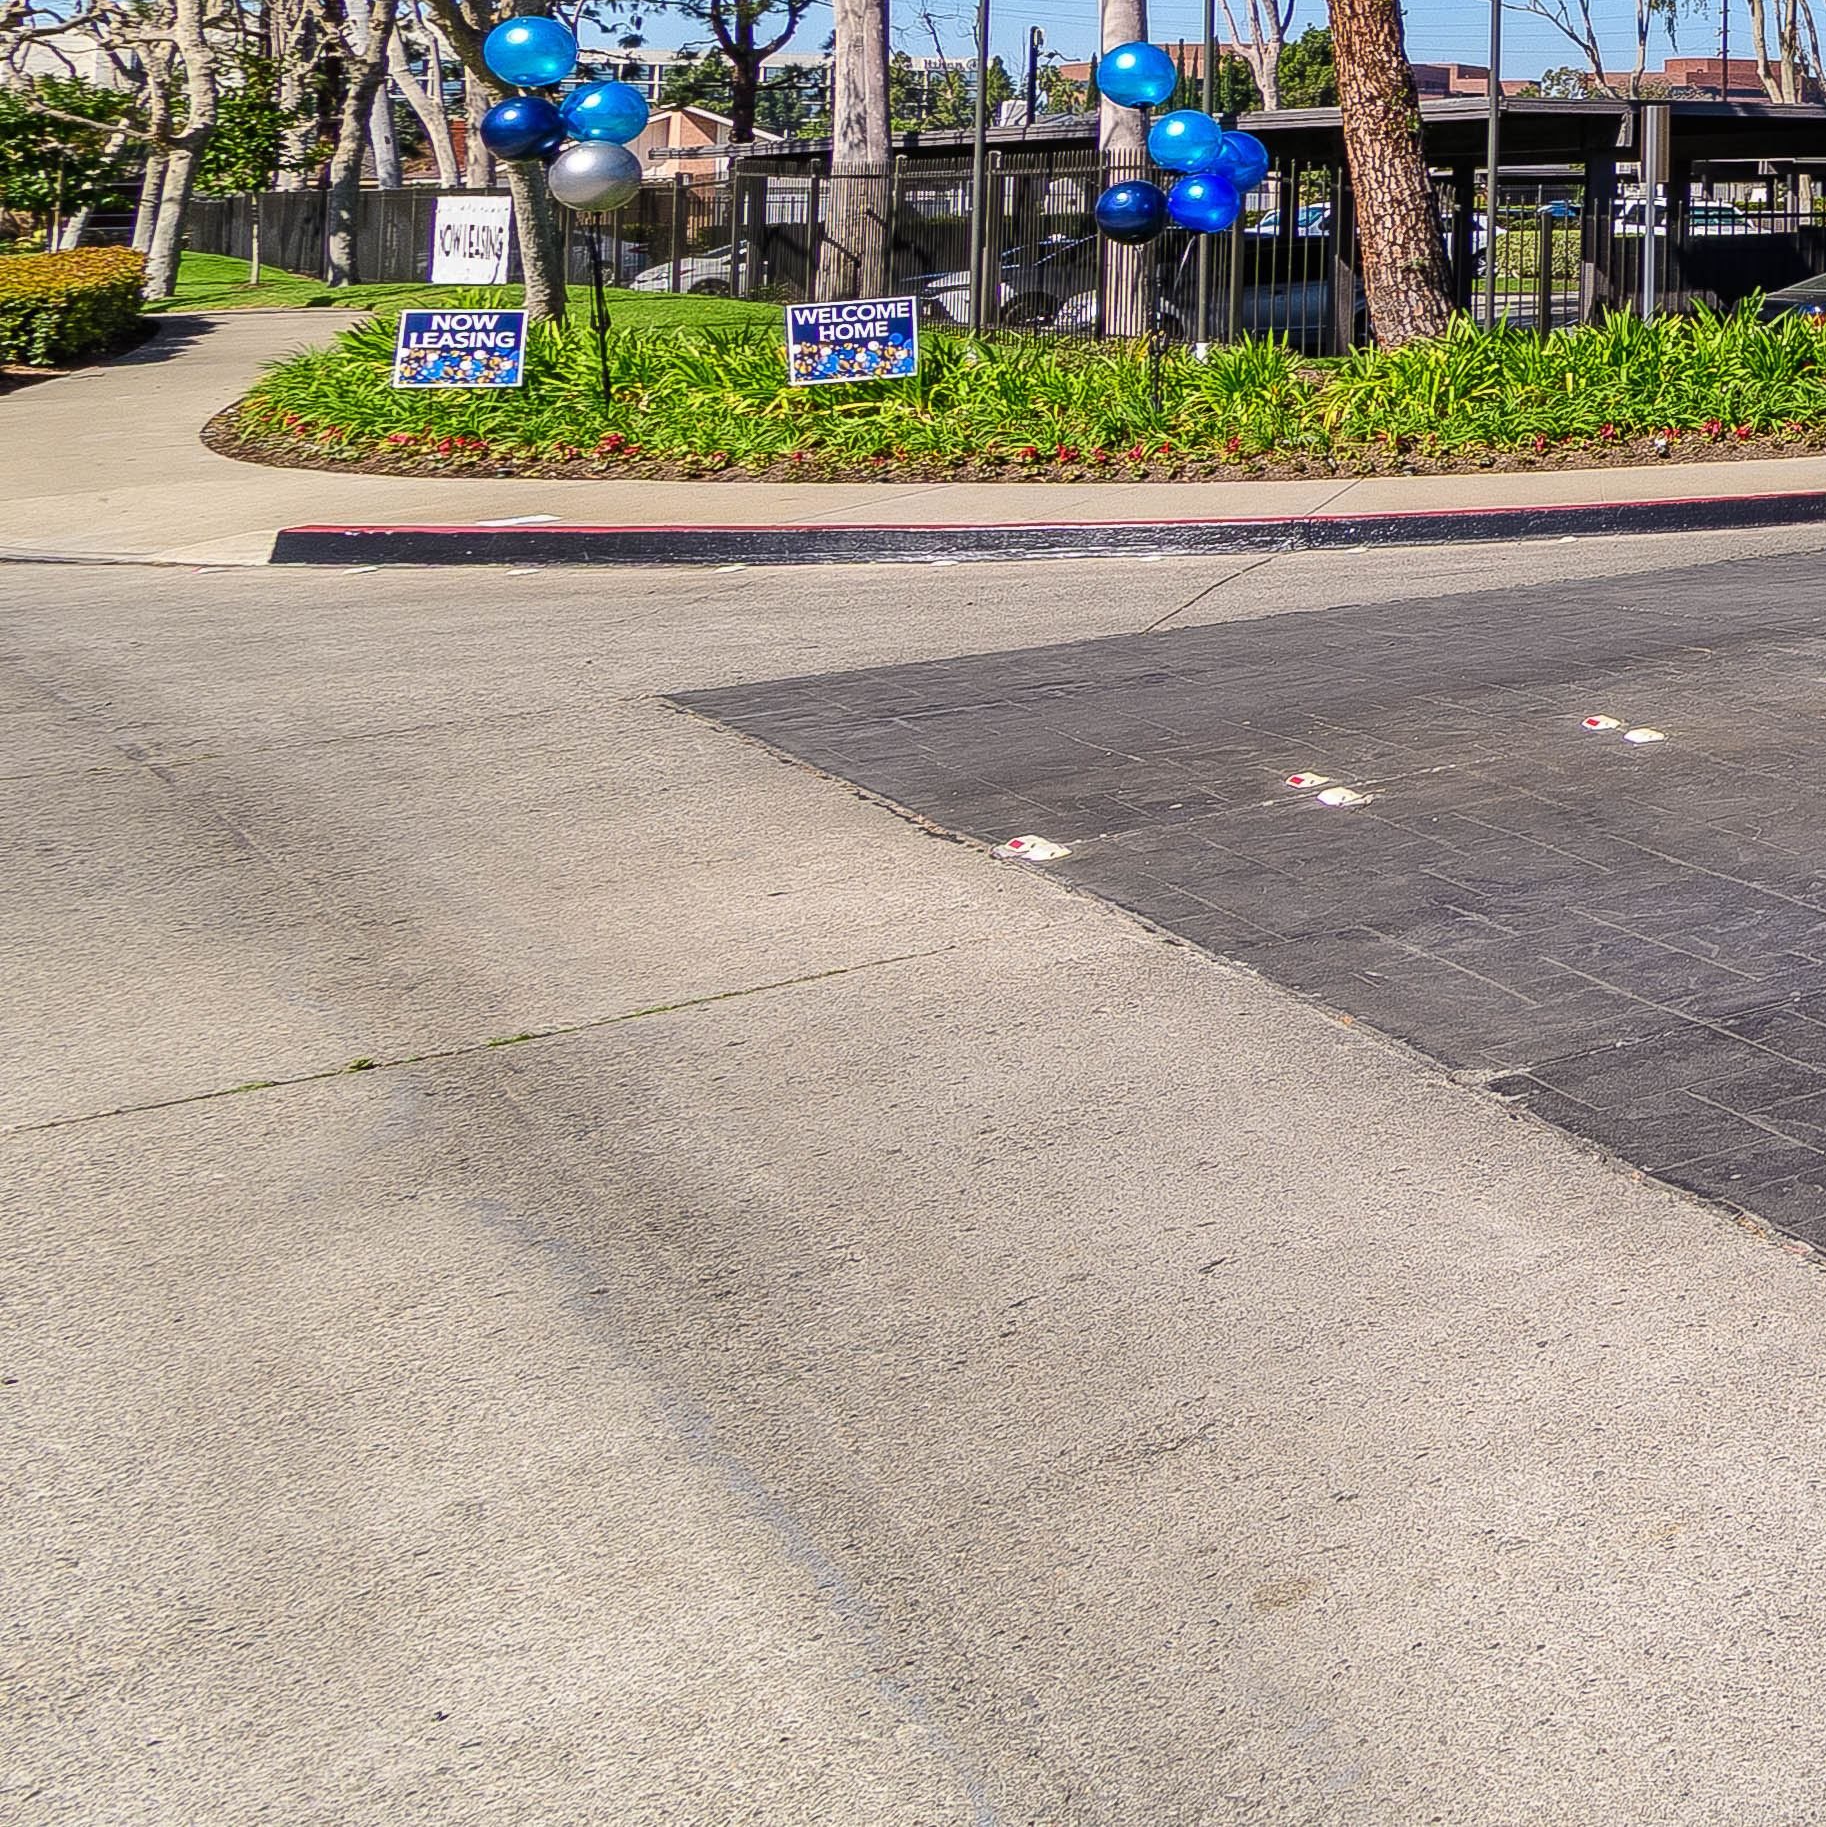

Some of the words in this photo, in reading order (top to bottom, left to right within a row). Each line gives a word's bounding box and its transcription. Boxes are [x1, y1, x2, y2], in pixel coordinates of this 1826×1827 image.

[430, 314, 500, 331] NOW
[793, 301, 911, 325] WELCOME
[408, 331, 516, 349] LEASING
[818, 320, 889, 342] HOME
